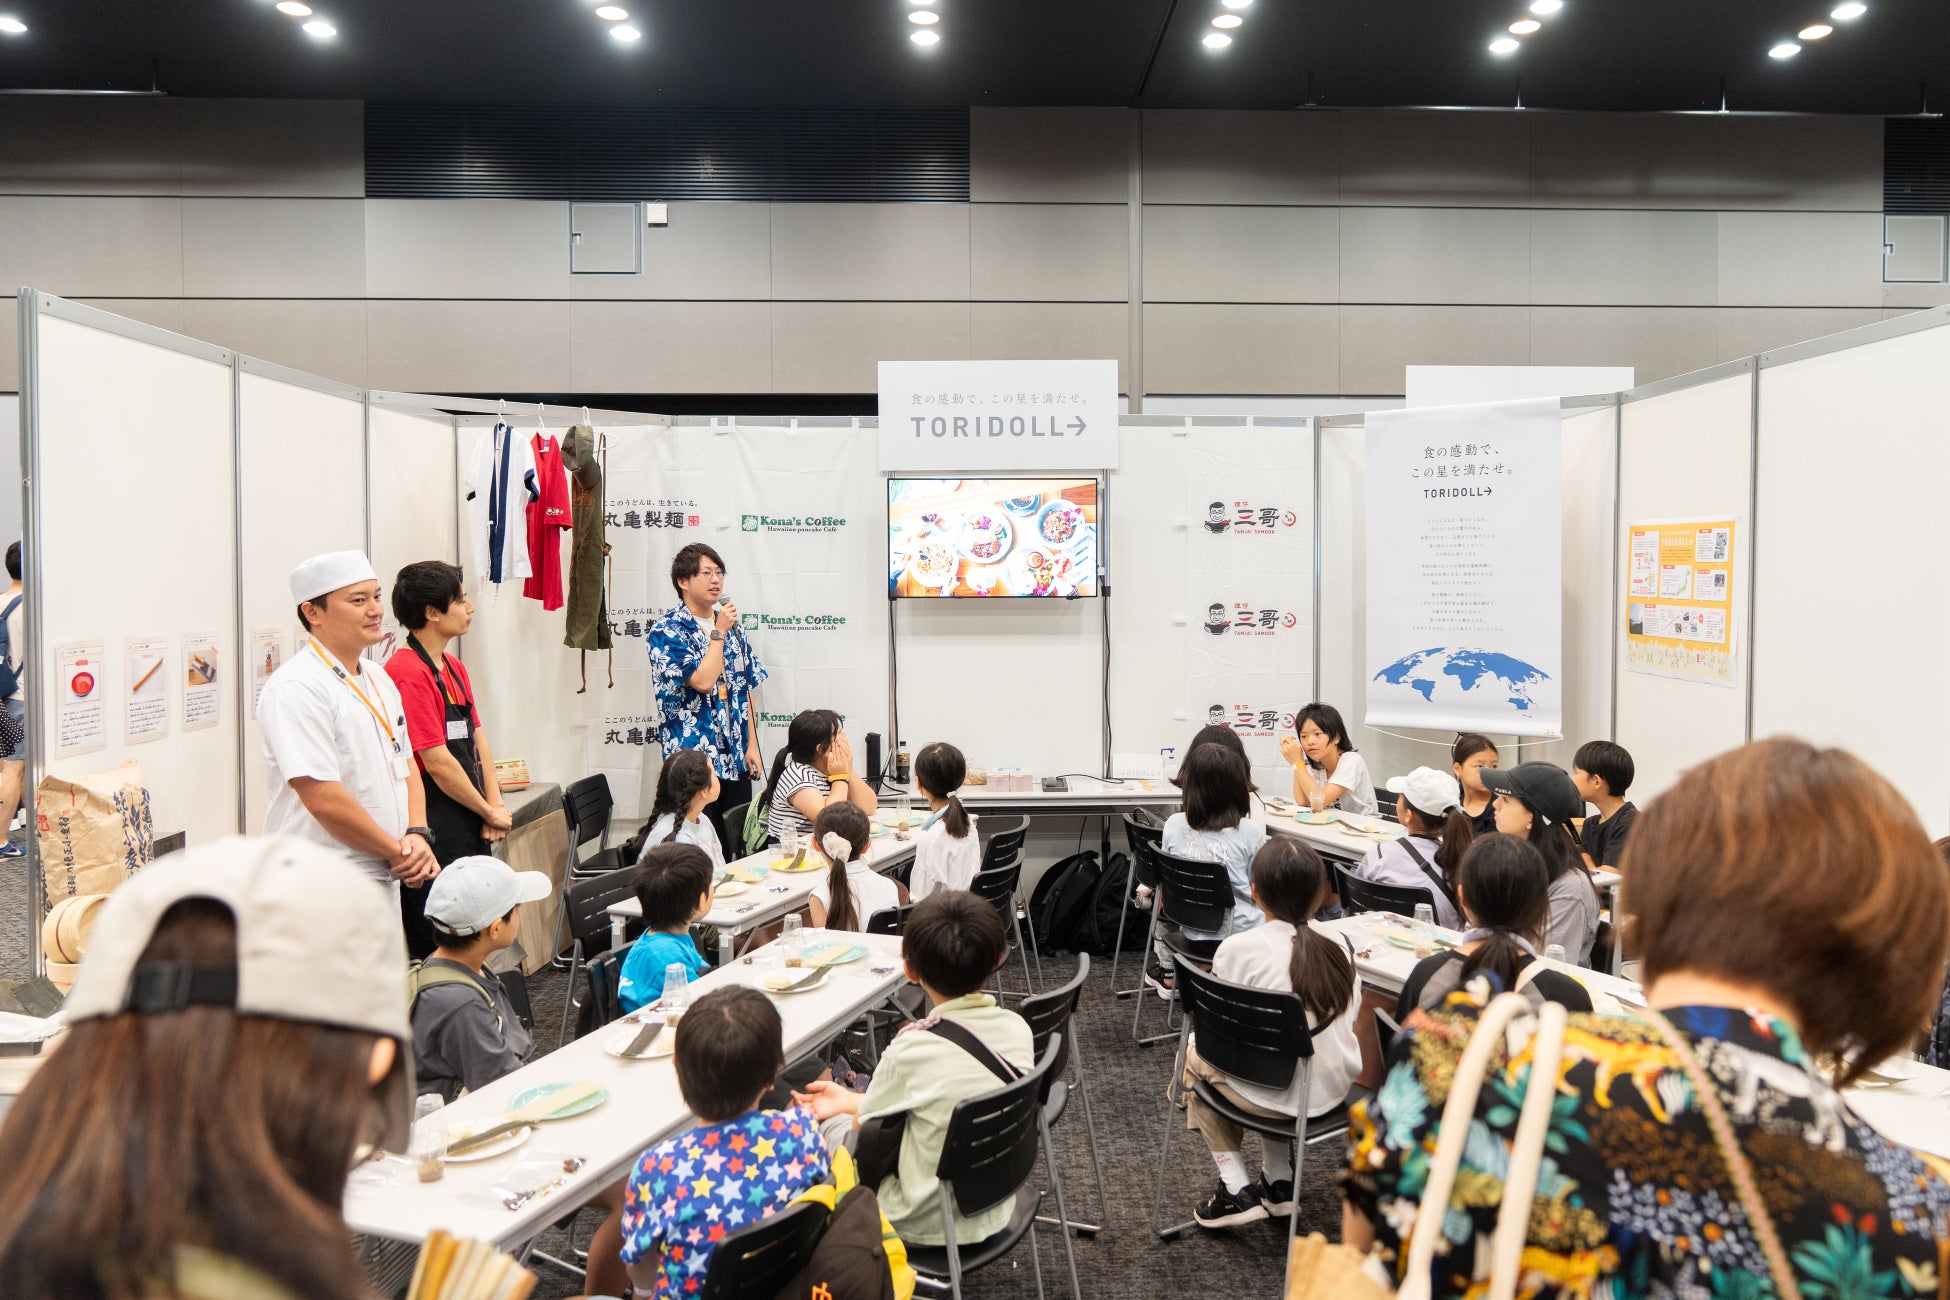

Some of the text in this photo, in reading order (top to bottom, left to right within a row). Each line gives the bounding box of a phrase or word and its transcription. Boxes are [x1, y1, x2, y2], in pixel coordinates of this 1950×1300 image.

[911, 393, 1088, 405] 食の感動で、この星を満たせ。
[911, 416, 1064, 438] TORIDOLL
[1423, 443, 1500, 459] 食の感動で、
[1411, 463, 1512, 478] この星を満たせ。
[1424, 487, 1483, 499] TORIDOLL
[604, 511, 684, 529] 丸亀製麺
[760, 515, 846, 526] Kona's Coffee
[1234, 508, 1280, 528] 三哥
[760, 614, 846, 625] Kona's Coffee
[1234, 609, 1280, 629] 三哥
[604, 716, 656, 724] ここのうどんは、
[760, 712, 796, 722] Kona'
[1234, 711, 1280, 730] 三哥
[604, 726, 660, 746] 丸亀製
[113, 790, 141, 878] 純正小麦
